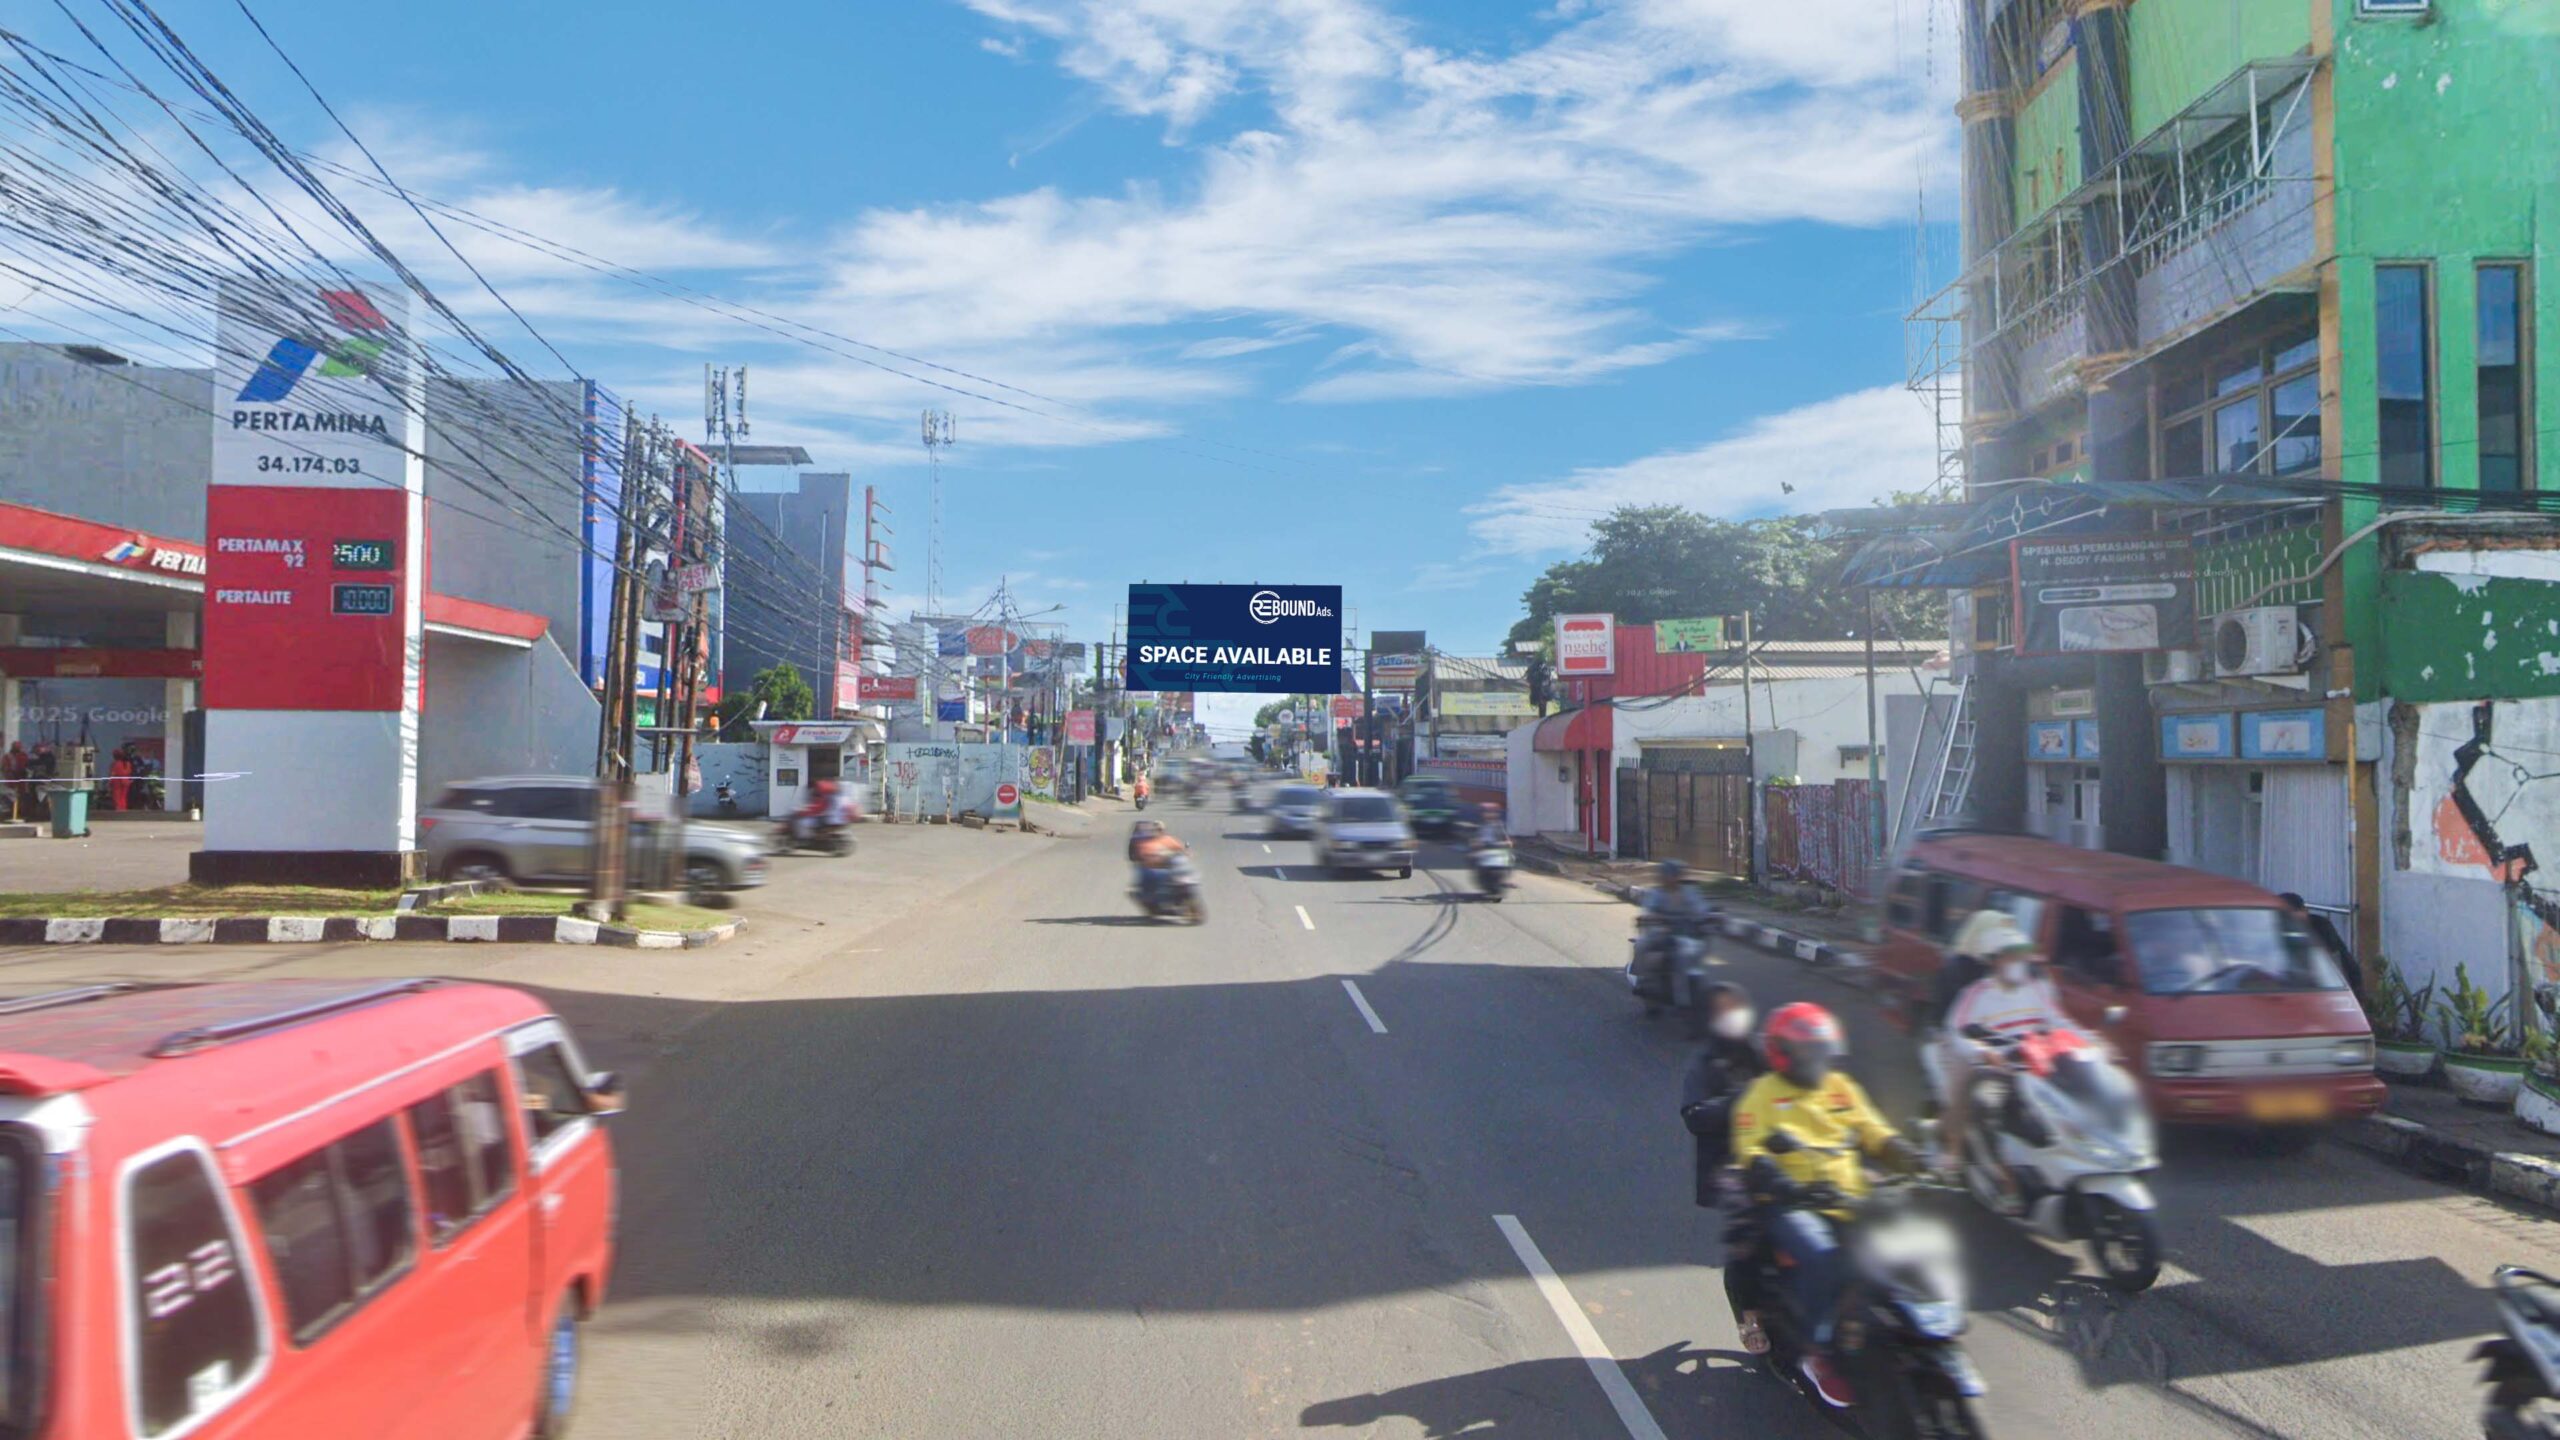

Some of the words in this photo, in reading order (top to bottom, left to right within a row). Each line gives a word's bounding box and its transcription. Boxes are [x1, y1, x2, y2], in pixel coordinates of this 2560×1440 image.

[233, 411, 387, 433] PERTAMINA
[258, 456, 360, 474] 34.174.03
[218, 538, 304, 553] PERTAMAX
[284, 555, 304, 567] 92
[216, 590, 291, 604] PERTALITE
[1316, 607, 1334, 617] Ads.
[1139, 645, 1208, 663] SPACE
[1213, 647, 1331, 665] AVAILABLE
[1184, 672, 1200, 681] City
[1202, 672, 1234, 681] Friendly
[1237, 673, 1282, 682] Advertising
